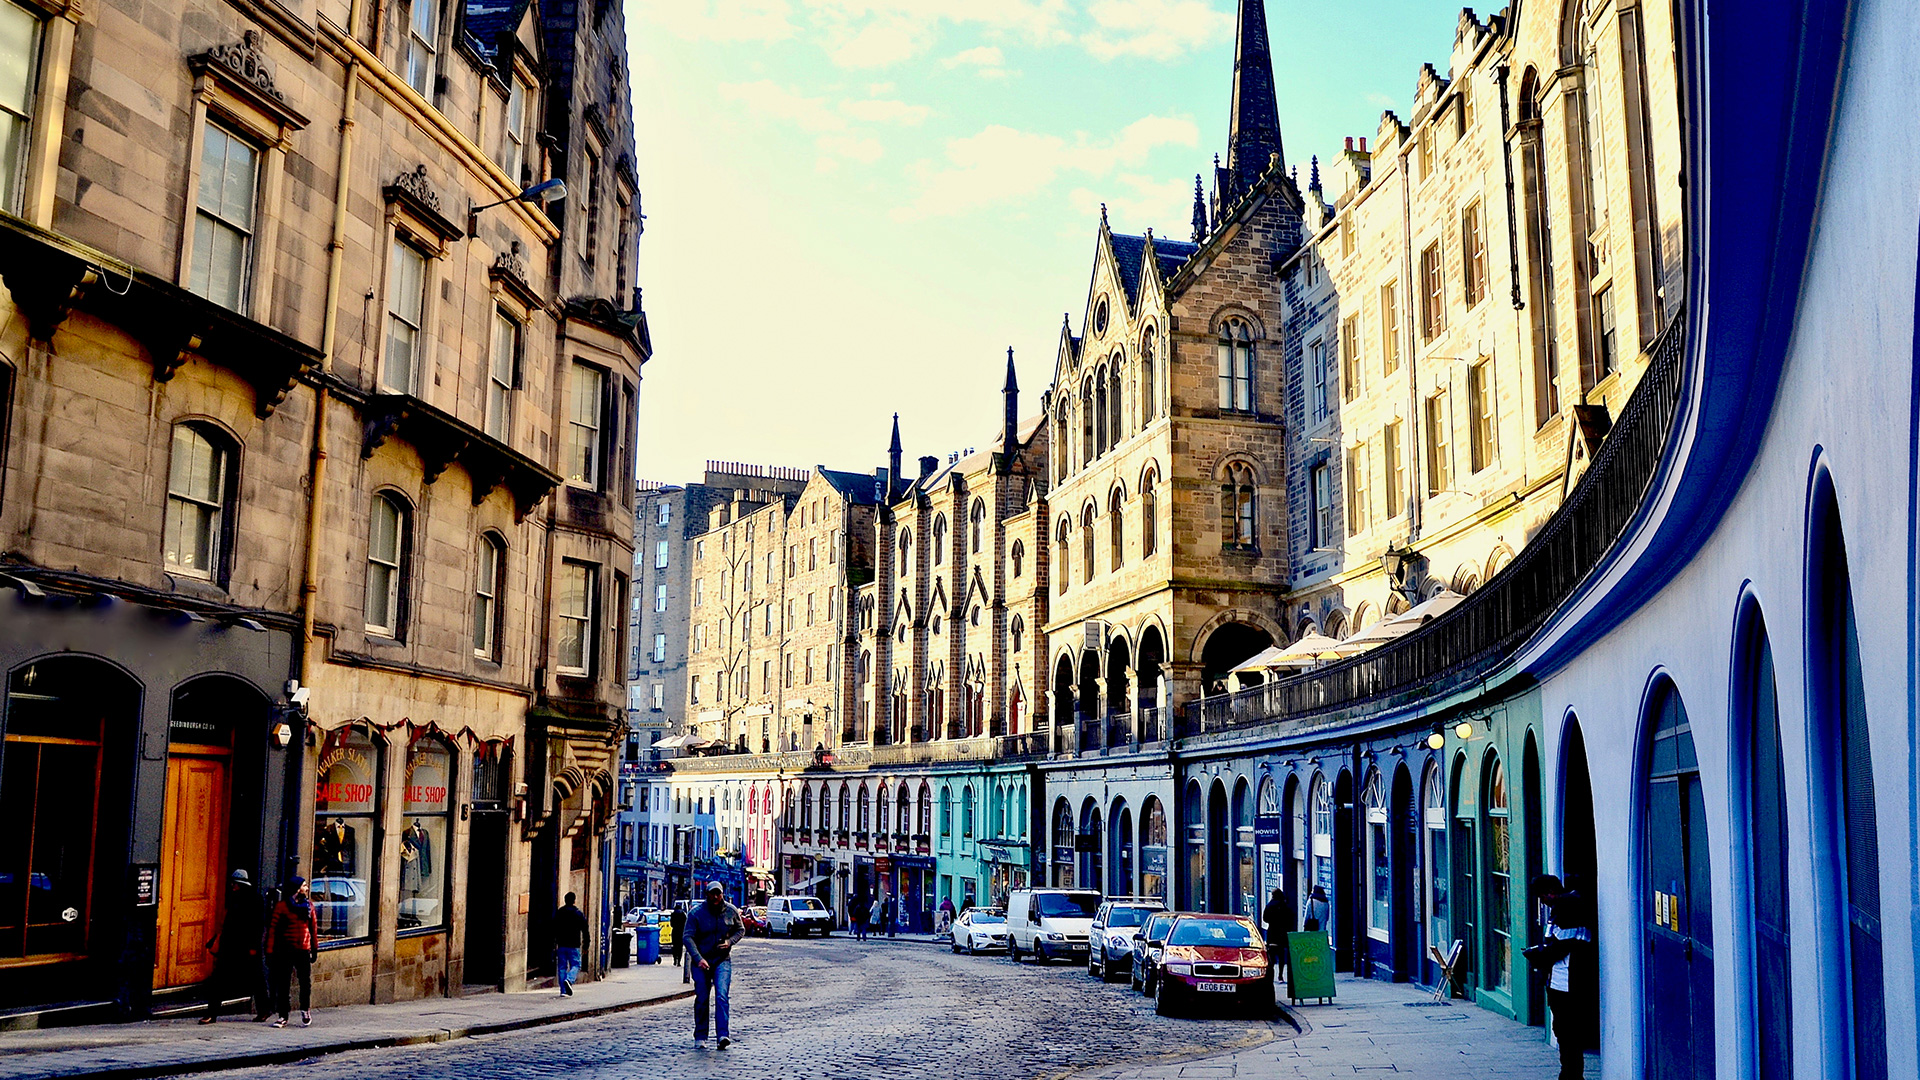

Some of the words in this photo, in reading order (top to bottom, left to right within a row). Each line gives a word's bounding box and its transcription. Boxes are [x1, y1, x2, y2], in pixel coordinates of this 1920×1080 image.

[317, 747, 345, 777] WALKER
[316, 782, 342, 802] SALE
[345, 784, 373, 803] SHOP
[425, 786, 446, 803] SHOP
